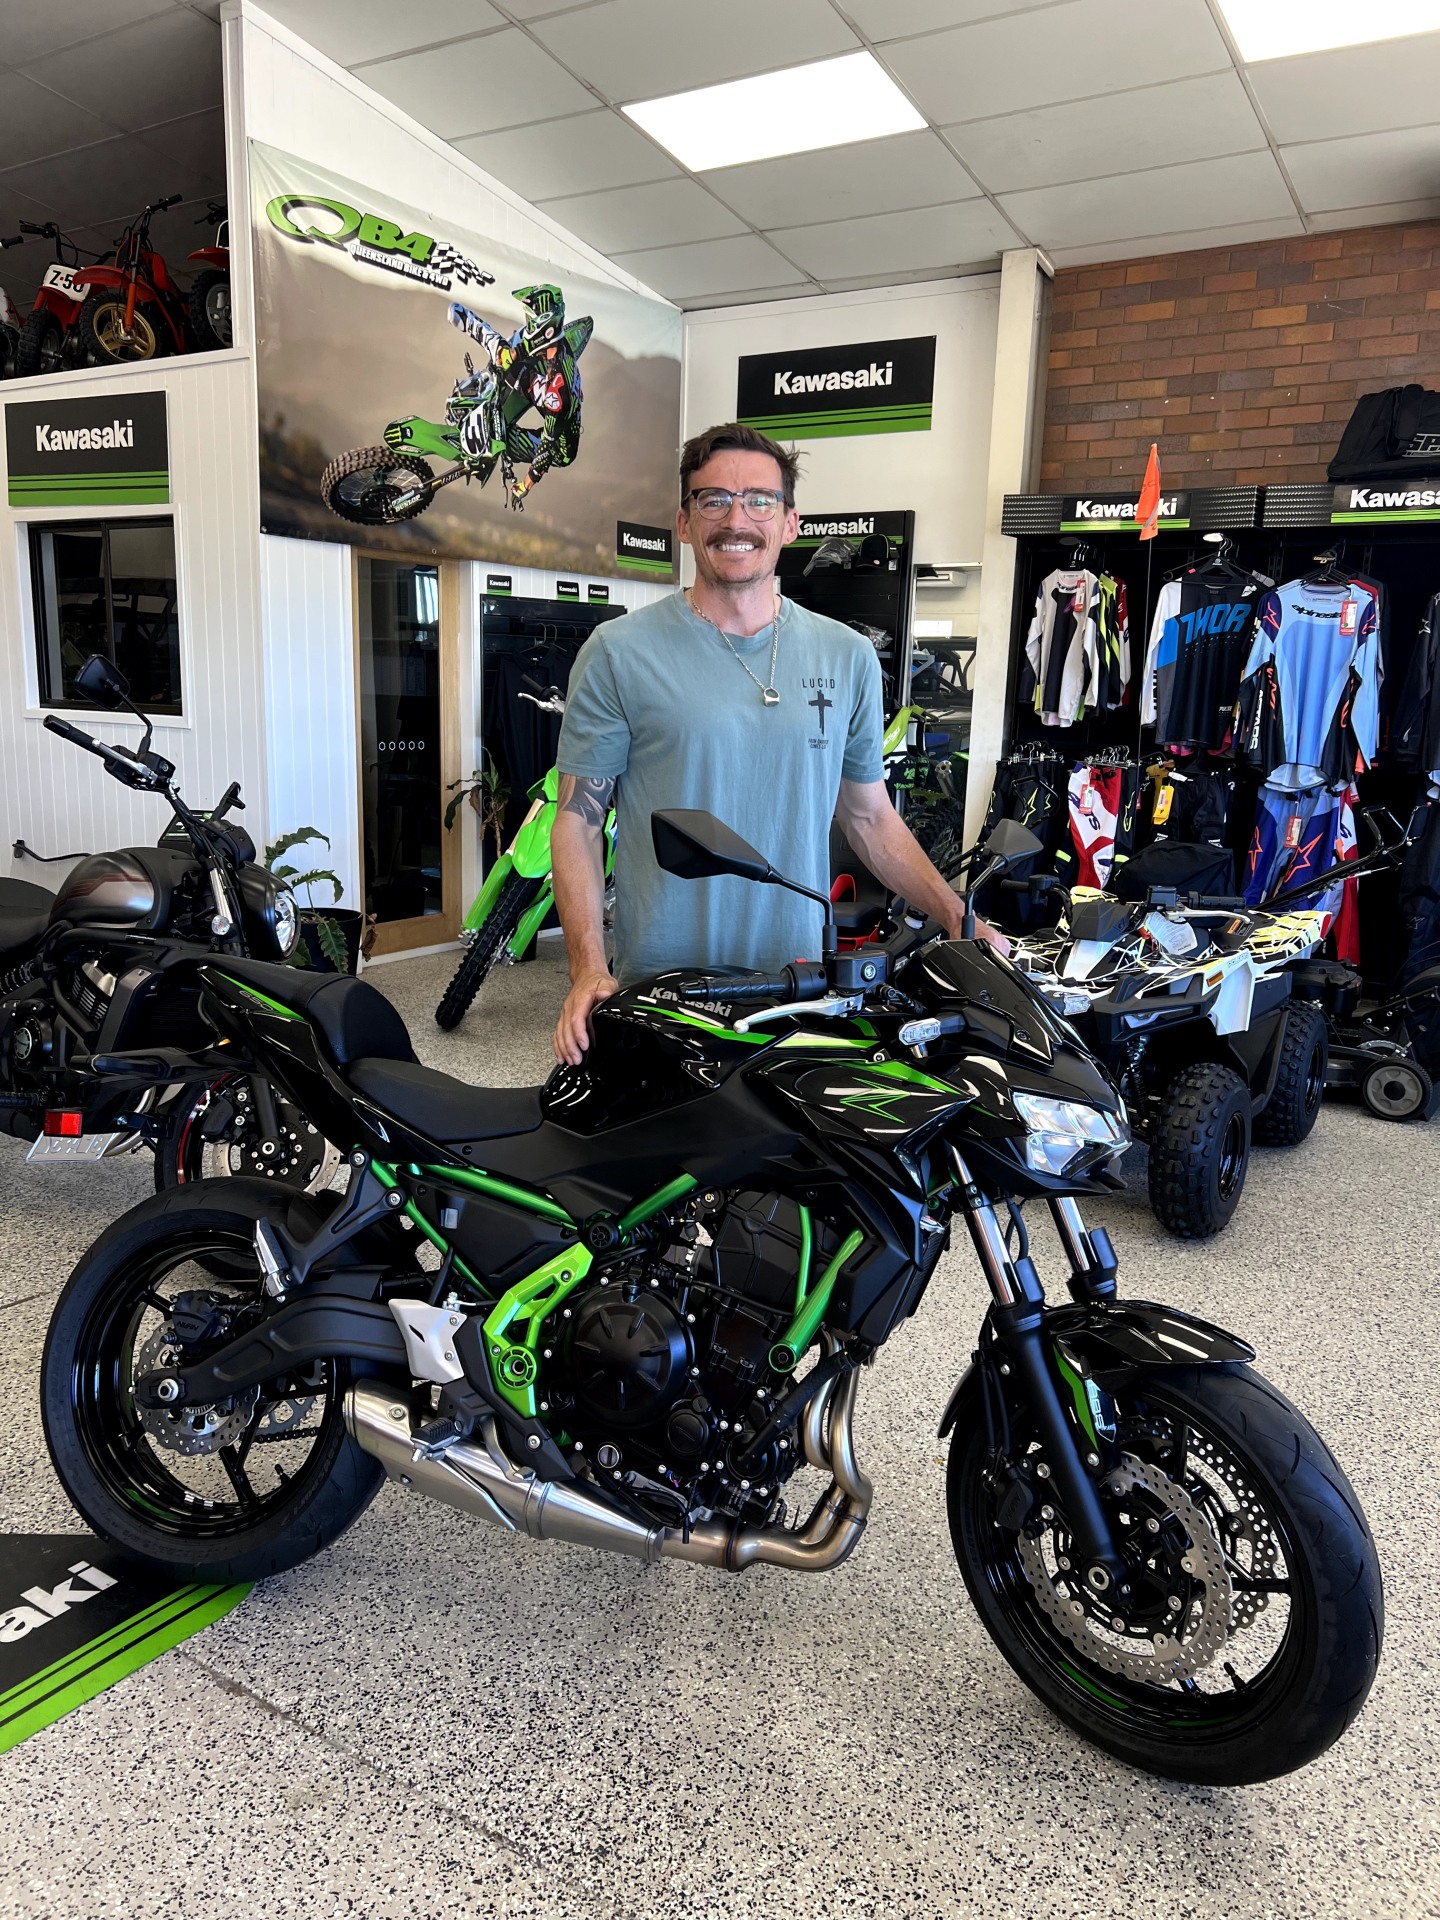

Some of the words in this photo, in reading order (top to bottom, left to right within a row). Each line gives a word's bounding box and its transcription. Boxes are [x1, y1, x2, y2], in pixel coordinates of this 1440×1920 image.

[266, 195, 434, 262] QB4
[350, 243, 404, 271] QUEENSLAND
[403, 263, 424, 279] BIKE
[429, 272, 450, 286] 4WD
[774, 362, 893, 395] Kawasaki
[36, 419, 134, 452] Kawasaki
[1075, 498, 1178, 518] Kawaki
[623, 533, 666, 552] Kawasaki
[489, 579, 510, 587] Kawasaki
[558, 585, 578, 593] Kawasaki
[589, 588, 608, 596] Kawasaki
[1180, 603, 1252, 645] THOR
[801, 677, 836, 690] LUCID
